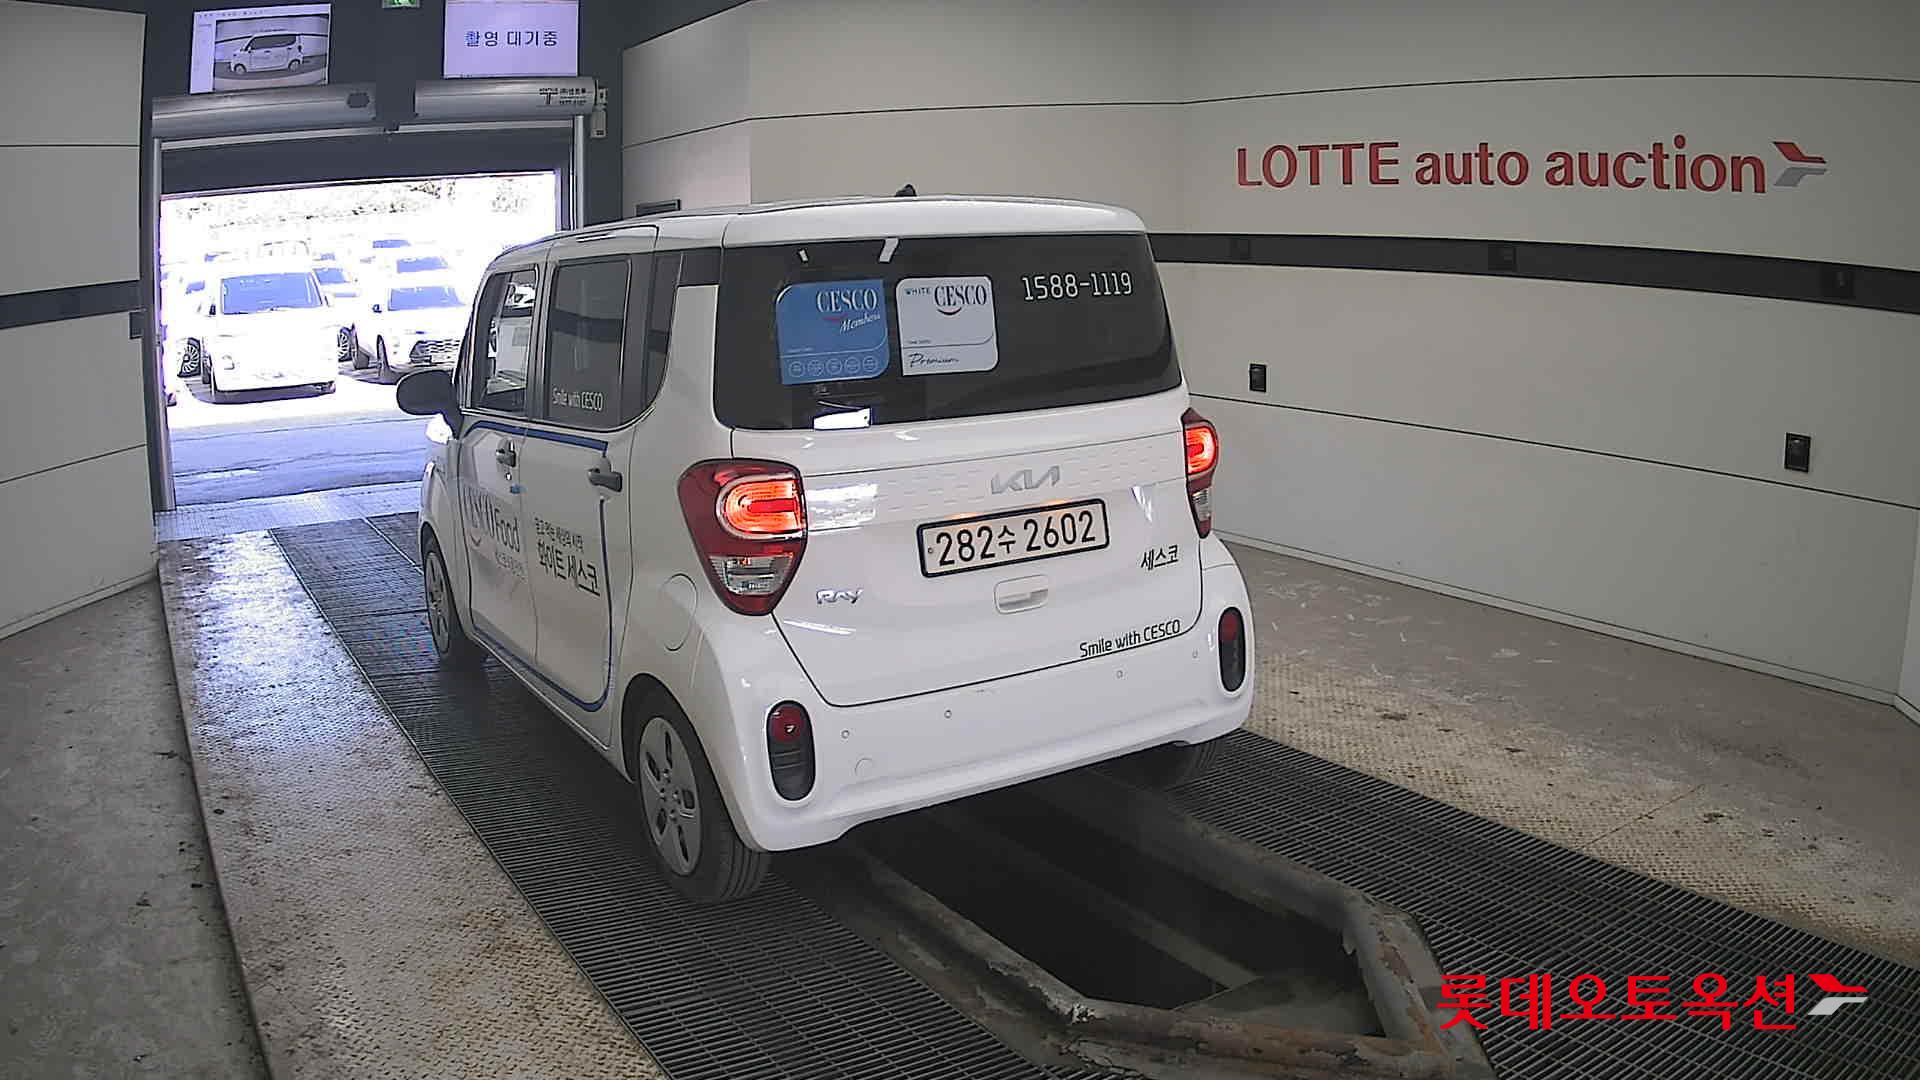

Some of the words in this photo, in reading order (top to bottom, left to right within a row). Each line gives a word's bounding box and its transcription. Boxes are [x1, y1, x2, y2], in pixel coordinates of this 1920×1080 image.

[465, 30, 499, 48] 촬영
[506, 30, 558, 47] 대기중
[1237, 141, 1400, 188] LOTTE
[1414, 142, 1530, 187] auto
[1544, 134, 1767, 194] auction
[904, 287, 931, 297] WHITE
[934, 284, 988, 307] CESCO
[1021, 271, 1133, 301] 1588-1119
[816, 287, 878, 313] CESCO
[581, 391, 604, 412] CESCO
[989, 465, 1062, 495] KIA
[935, 525, 1017, 567] 282수
[1022, 509, 1097, 553] 2602
[1140, 544, 1180, 571] 세스코
[815, 588, 864, 605] RAY
[1079, 637, 1113, 658] Smile
[1114, 630, 1141, 649] with
[1143, 619, 1181, 642] CESCO
